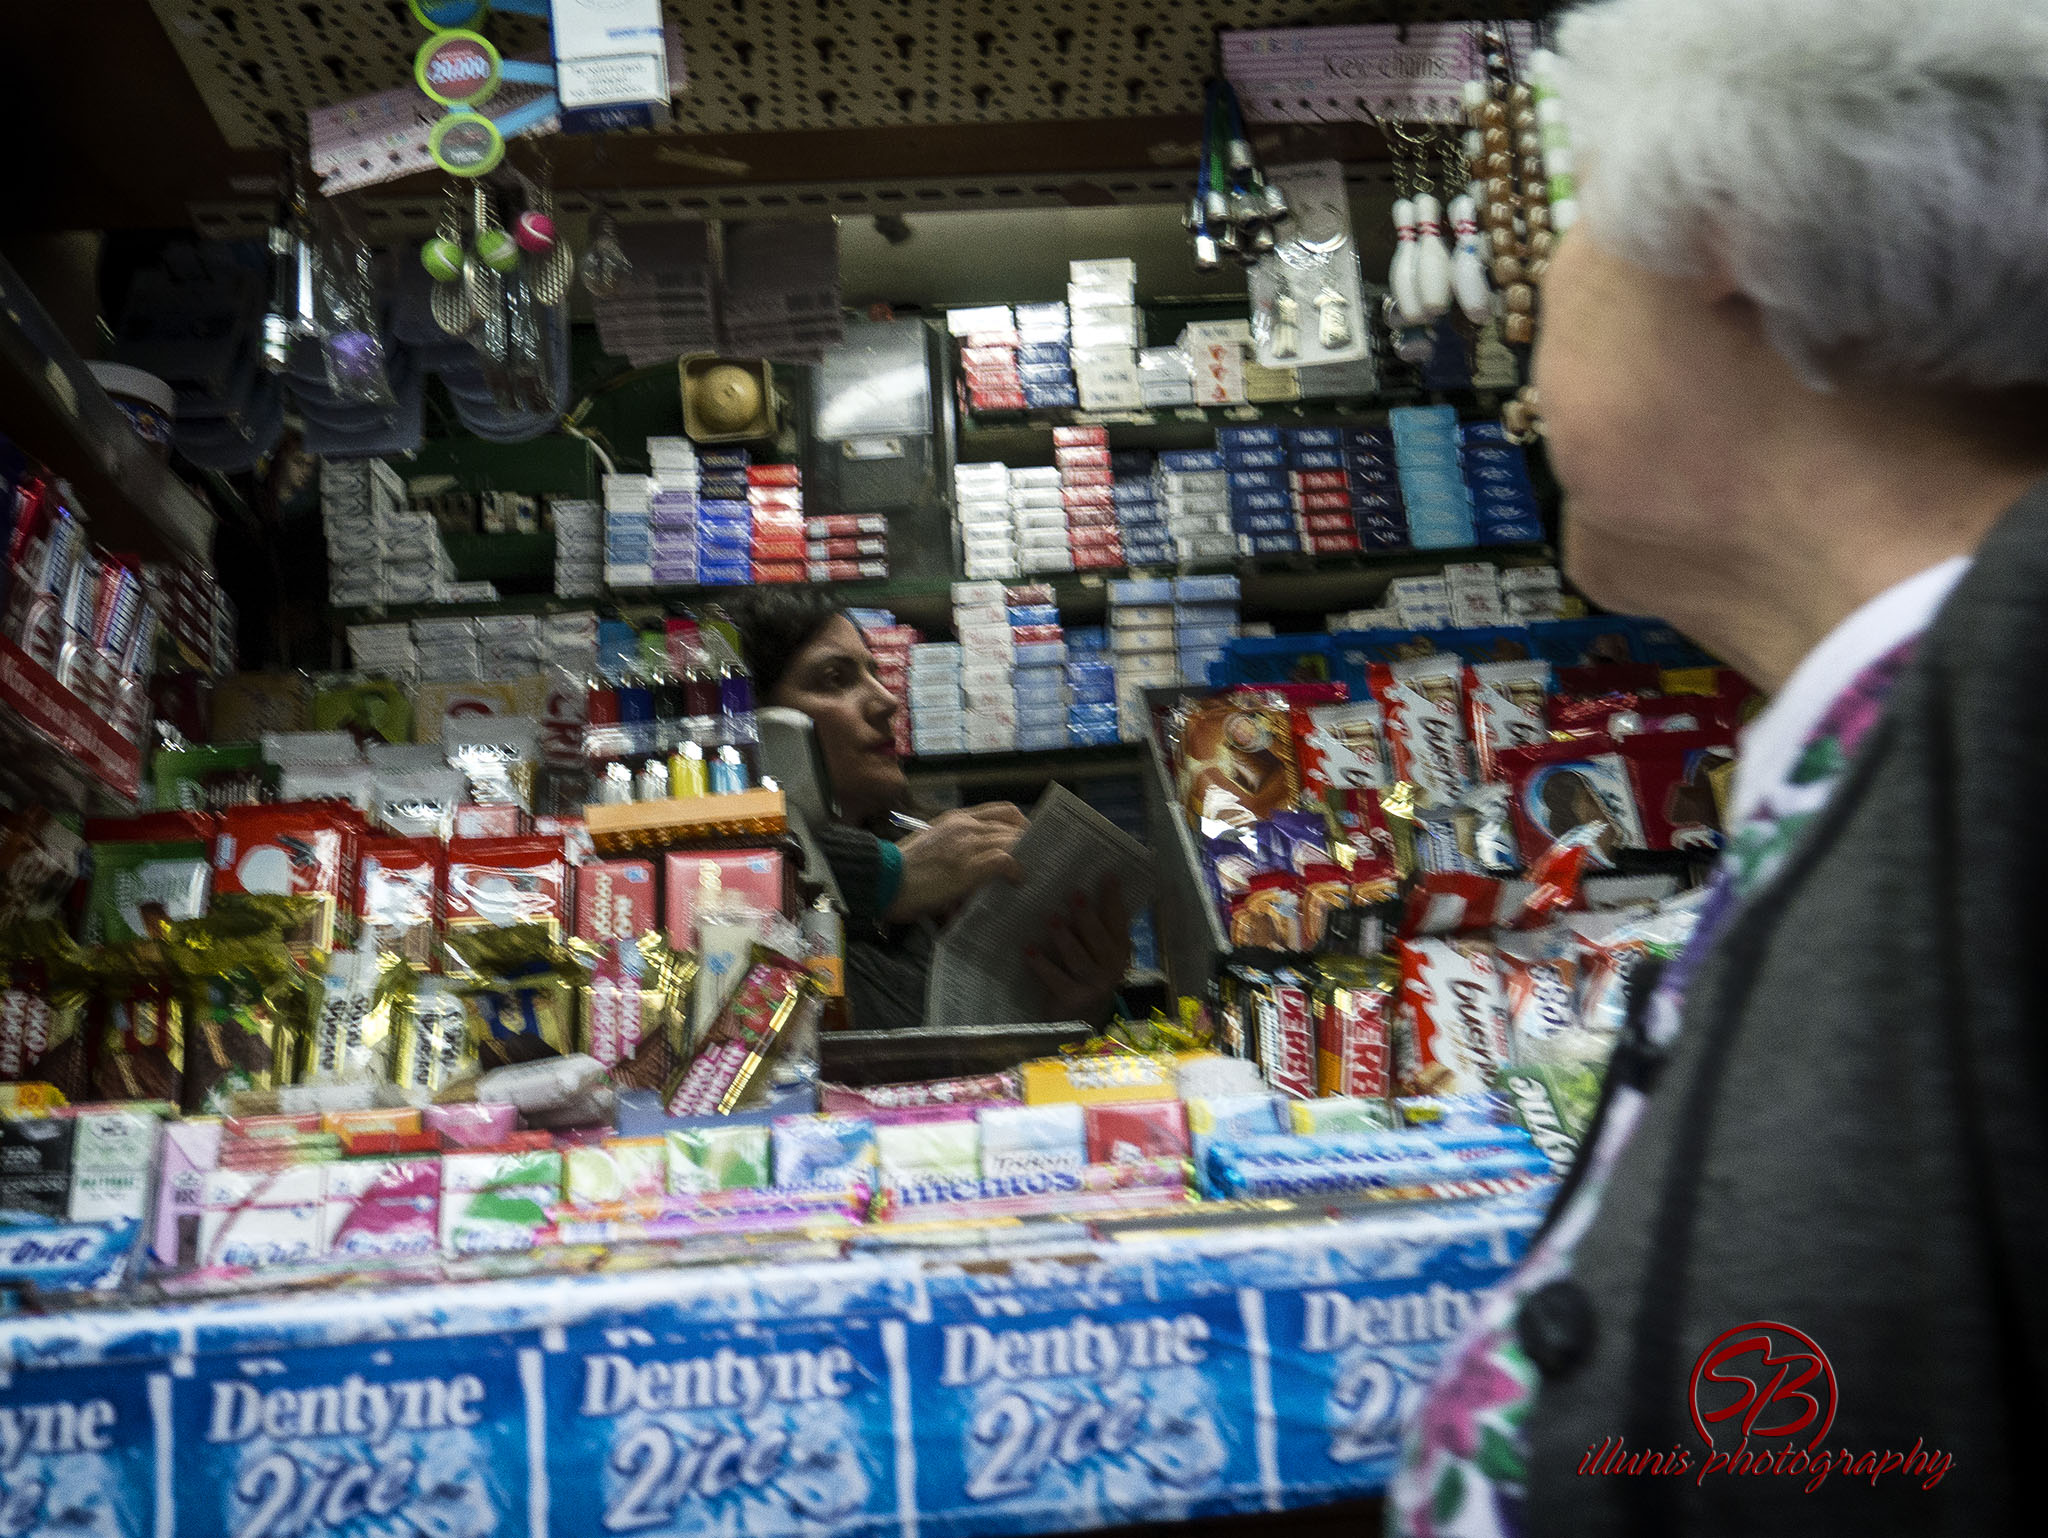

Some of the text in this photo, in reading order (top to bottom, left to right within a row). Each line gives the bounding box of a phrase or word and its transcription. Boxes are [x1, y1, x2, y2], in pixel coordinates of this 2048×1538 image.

[581, 1345, 853, 1418] Dentyne
[940, 1312, 1211, 1387] Dentyne
[0, 1399, 117, 1468] yne
[207, 1373, 486, 1446] Dentyne
